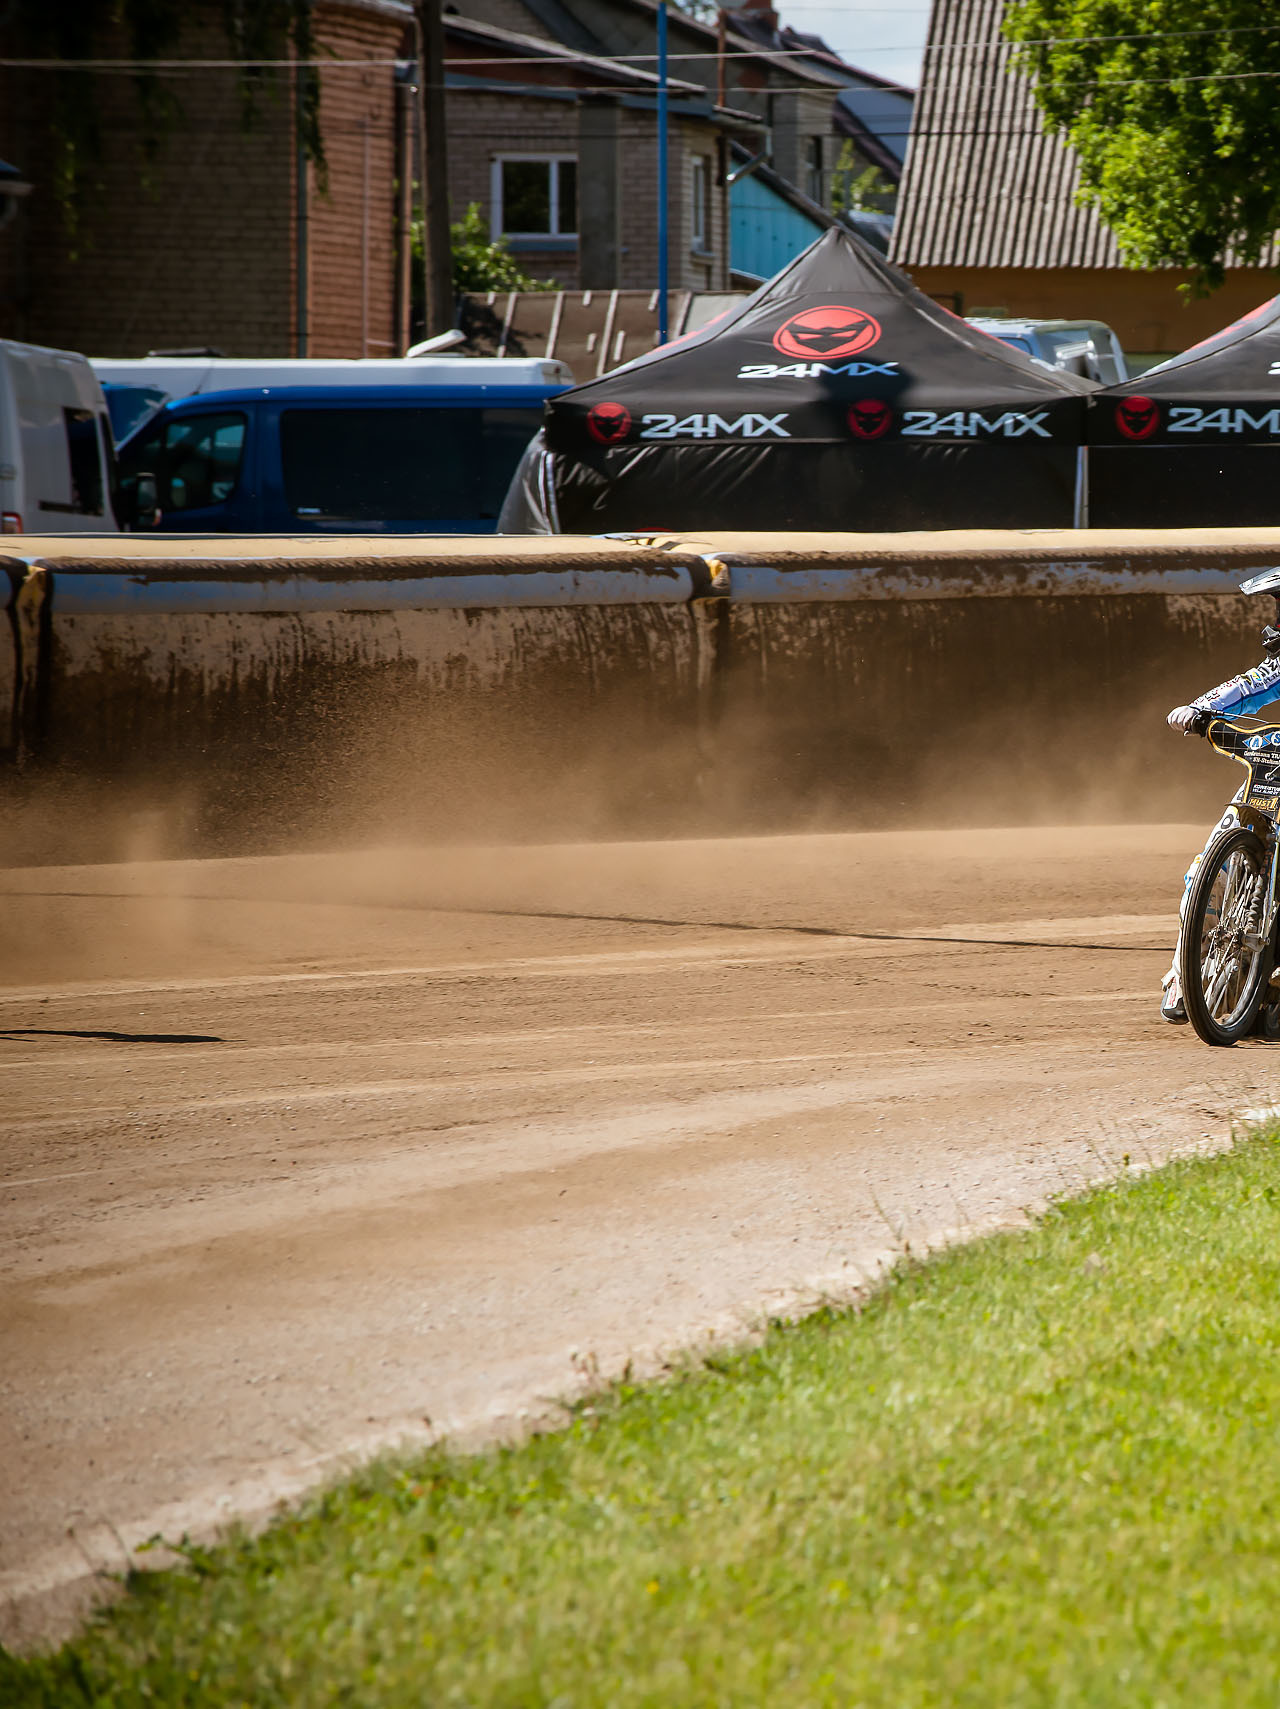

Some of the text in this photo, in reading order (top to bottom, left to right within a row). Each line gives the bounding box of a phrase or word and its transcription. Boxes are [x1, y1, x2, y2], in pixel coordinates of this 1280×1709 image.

[737, 362, 899, 379] 24MX
[640, 413, 792, 438] 24MX
[901, 411, 1053, 438] 24MX
